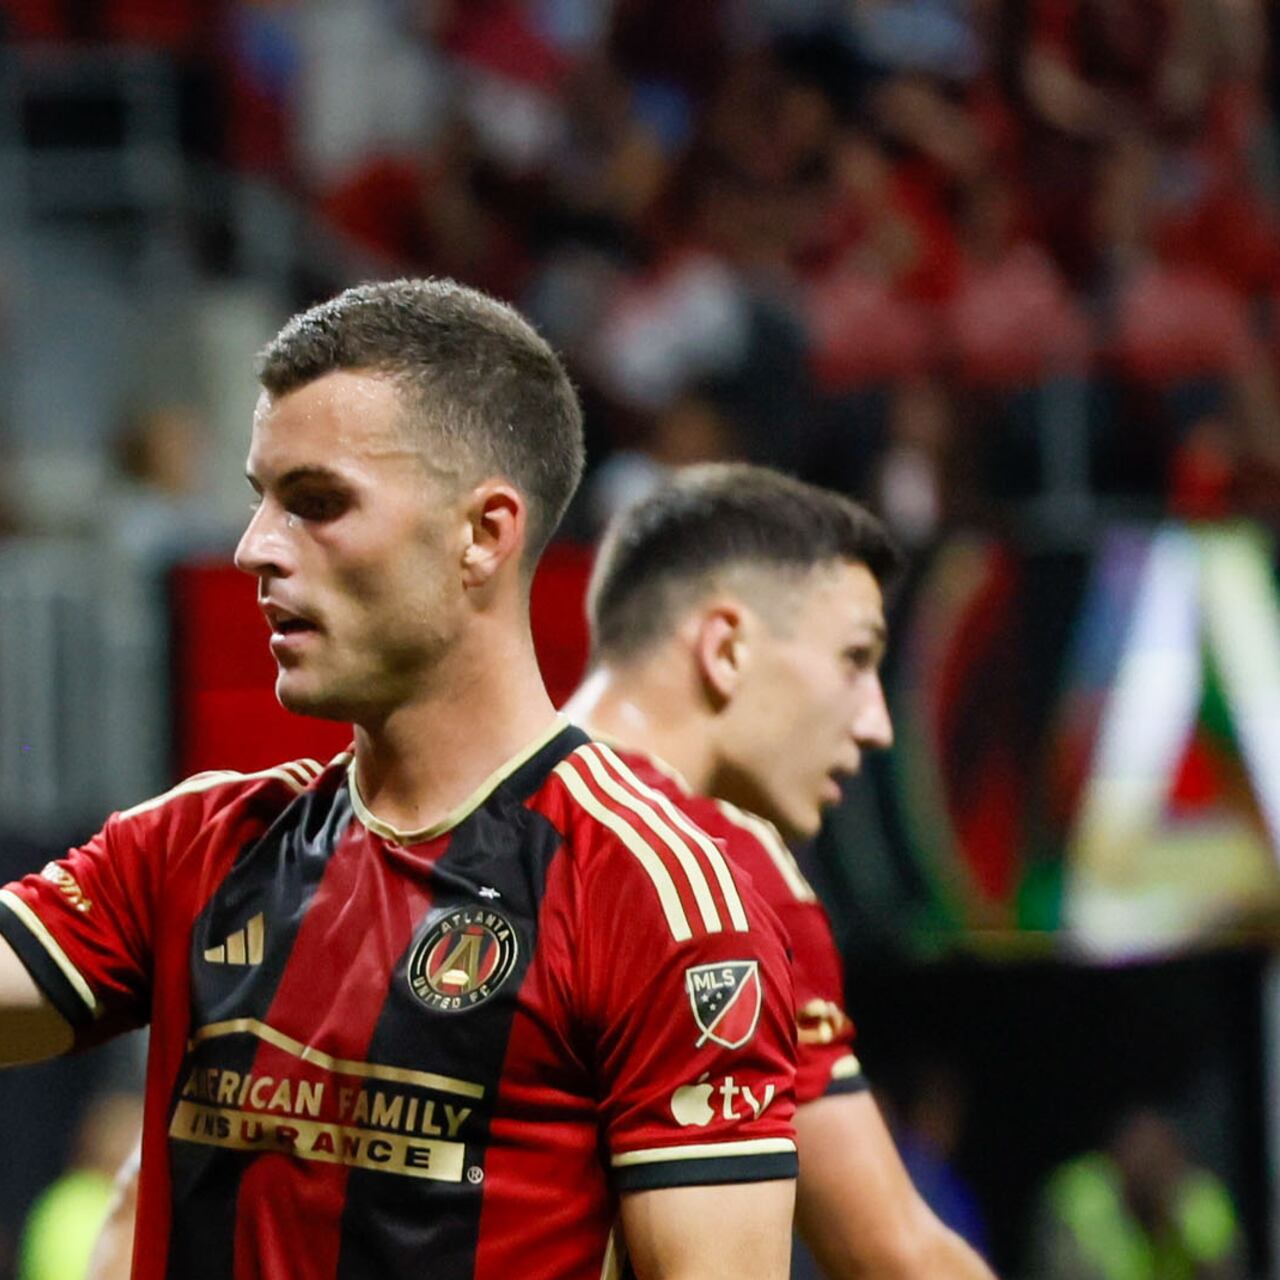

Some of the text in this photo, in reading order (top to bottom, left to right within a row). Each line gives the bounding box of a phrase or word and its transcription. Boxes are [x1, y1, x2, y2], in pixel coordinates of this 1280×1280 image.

[441, 911, 510, 942] ATLANTA
[413, 976, 461, 1009] UNITED
[692, 968, 737, 992] MLS
[339, 1086, 472, 1138] FAMILY
[719, 1075, 776, 1121] tv
[190, 1111, 432, 1169] INSURANCE
